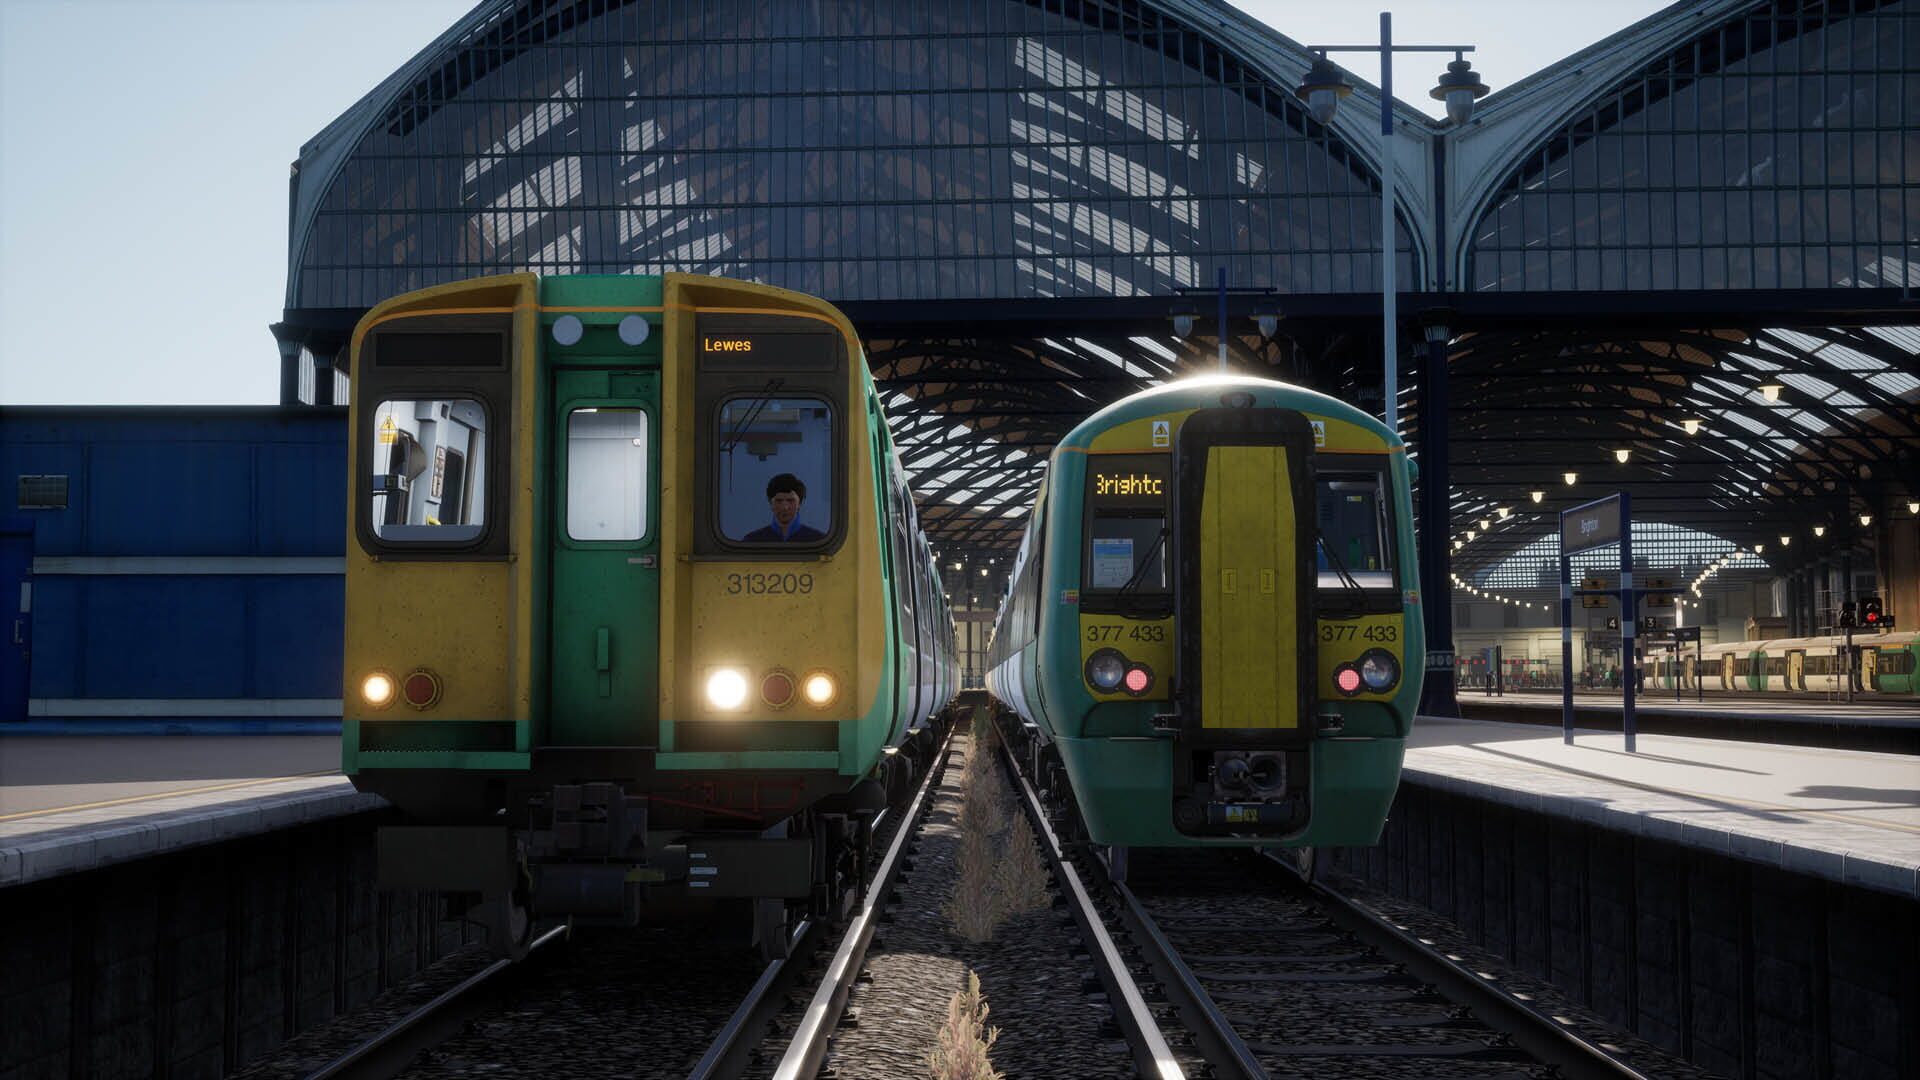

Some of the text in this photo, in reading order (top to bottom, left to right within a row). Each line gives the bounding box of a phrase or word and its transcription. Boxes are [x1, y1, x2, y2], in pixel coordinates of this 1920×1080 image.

[704, 338, 752, 352] Lewes
[727, 573, 813, 594] 313209
[1087, 625, 1165, 642] 377 433
[1321, 625, 1397, 642] 377 433
